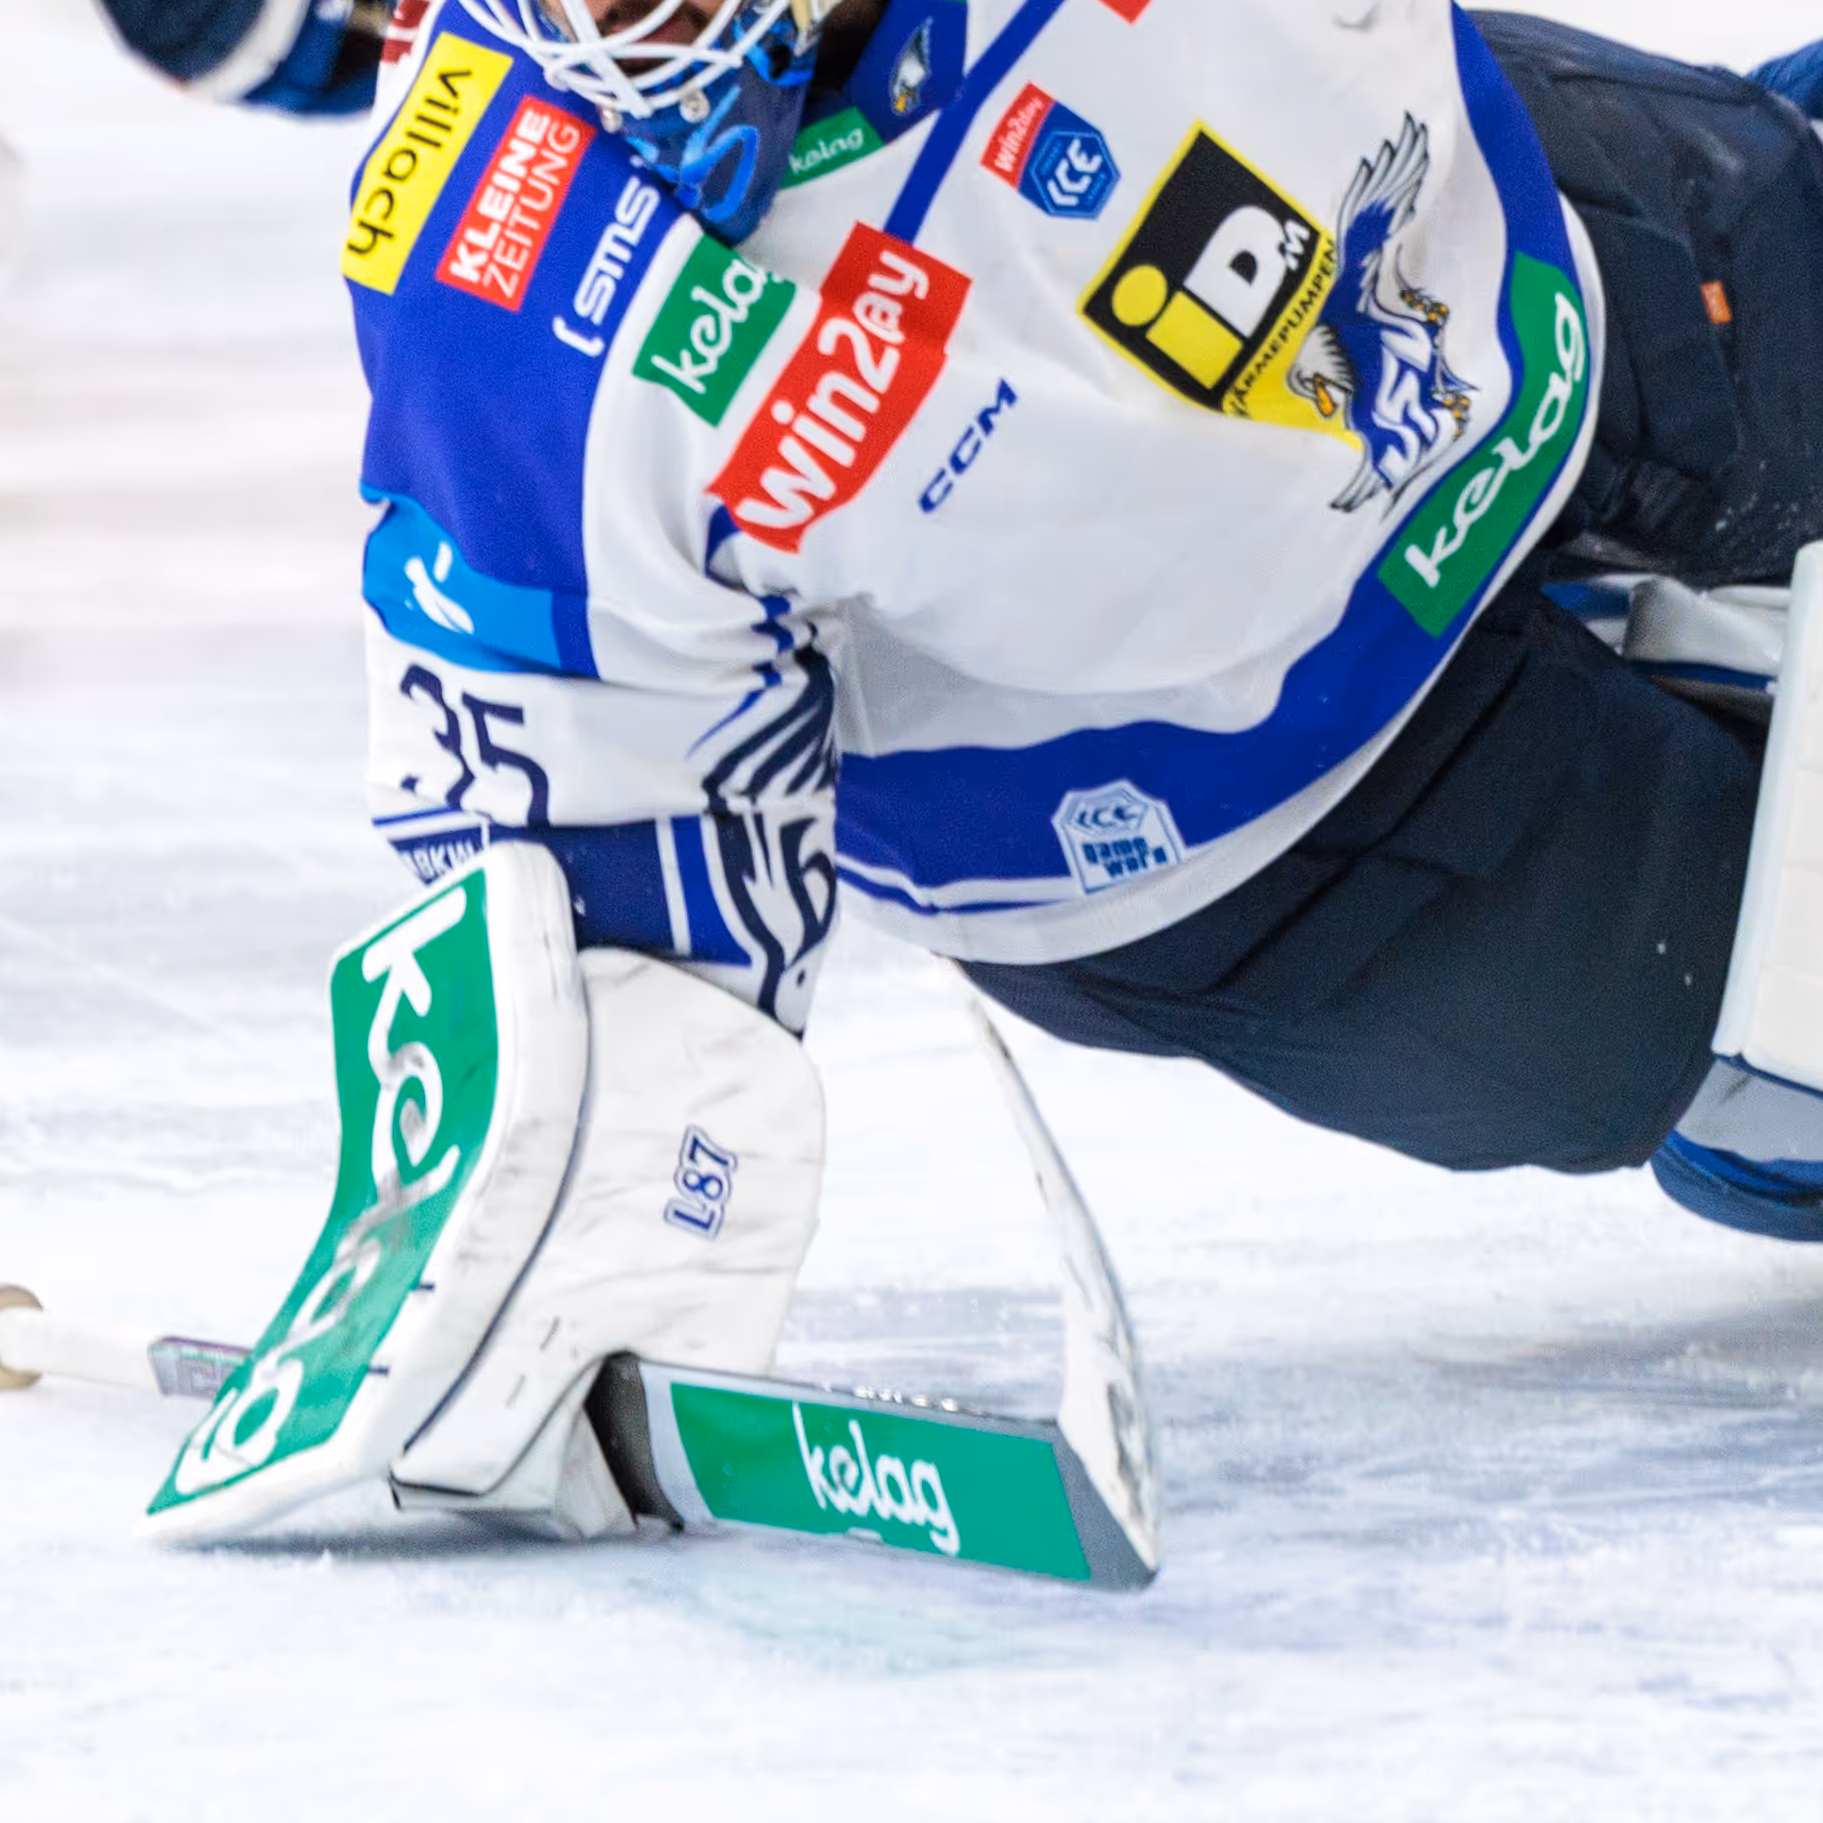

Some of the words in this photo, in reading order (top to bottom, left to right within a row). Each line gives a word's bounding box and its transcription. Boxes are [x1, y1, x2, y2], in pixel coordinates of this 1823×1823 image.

[346, 67, 474, 258] villach
[450, 108, 550, 282] KLEINE
[483, 121, 582, 298] ZEITUNG
[652, 258, 786, 396] kela
[918, 377, 1019, 514] CCM
[1404, 290, 1583, 589] kelag
[399, 663, 551, 831] 35
[663, 1125, 740, 1240] L87
[790, 1399, 962, 1558] kelag
